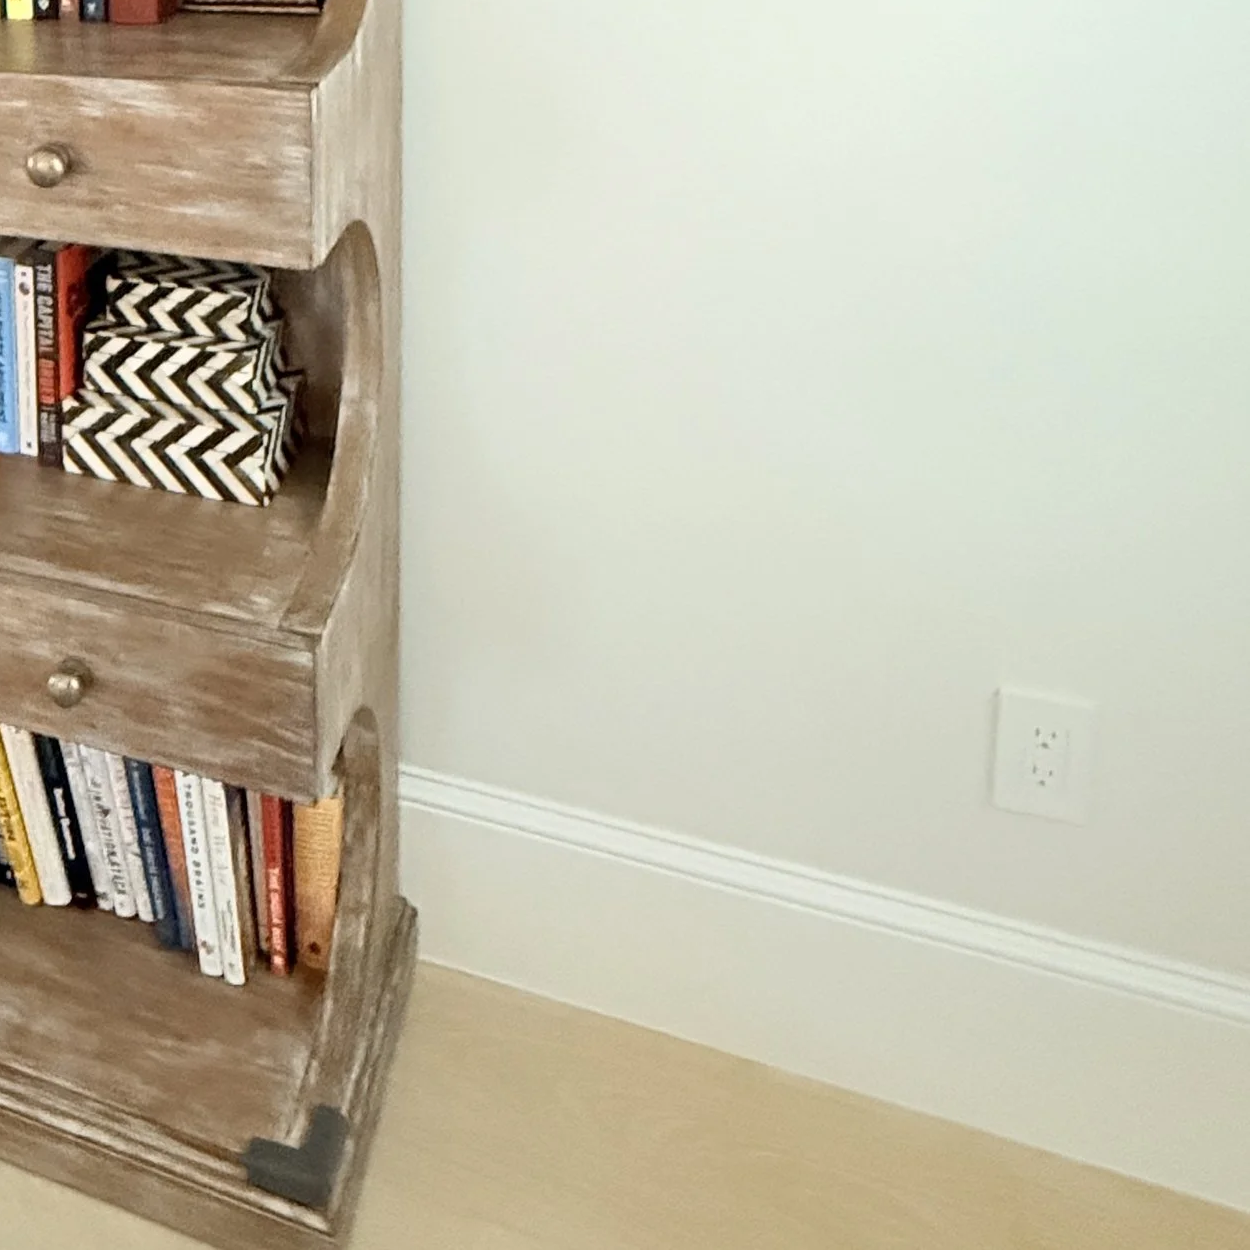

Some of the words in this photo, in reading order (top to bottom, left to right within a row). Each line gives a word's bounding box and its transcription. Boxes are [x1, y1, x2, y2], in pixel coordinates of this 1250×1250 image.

[37, 264, 53, 292] THE
[38, 295, 54, 353] CAPITAL
[39, 358, 55, 404] ORDER
[183, 783, 199, 854] THOUSAND
[190, 860, 206, 909] BRAINS
